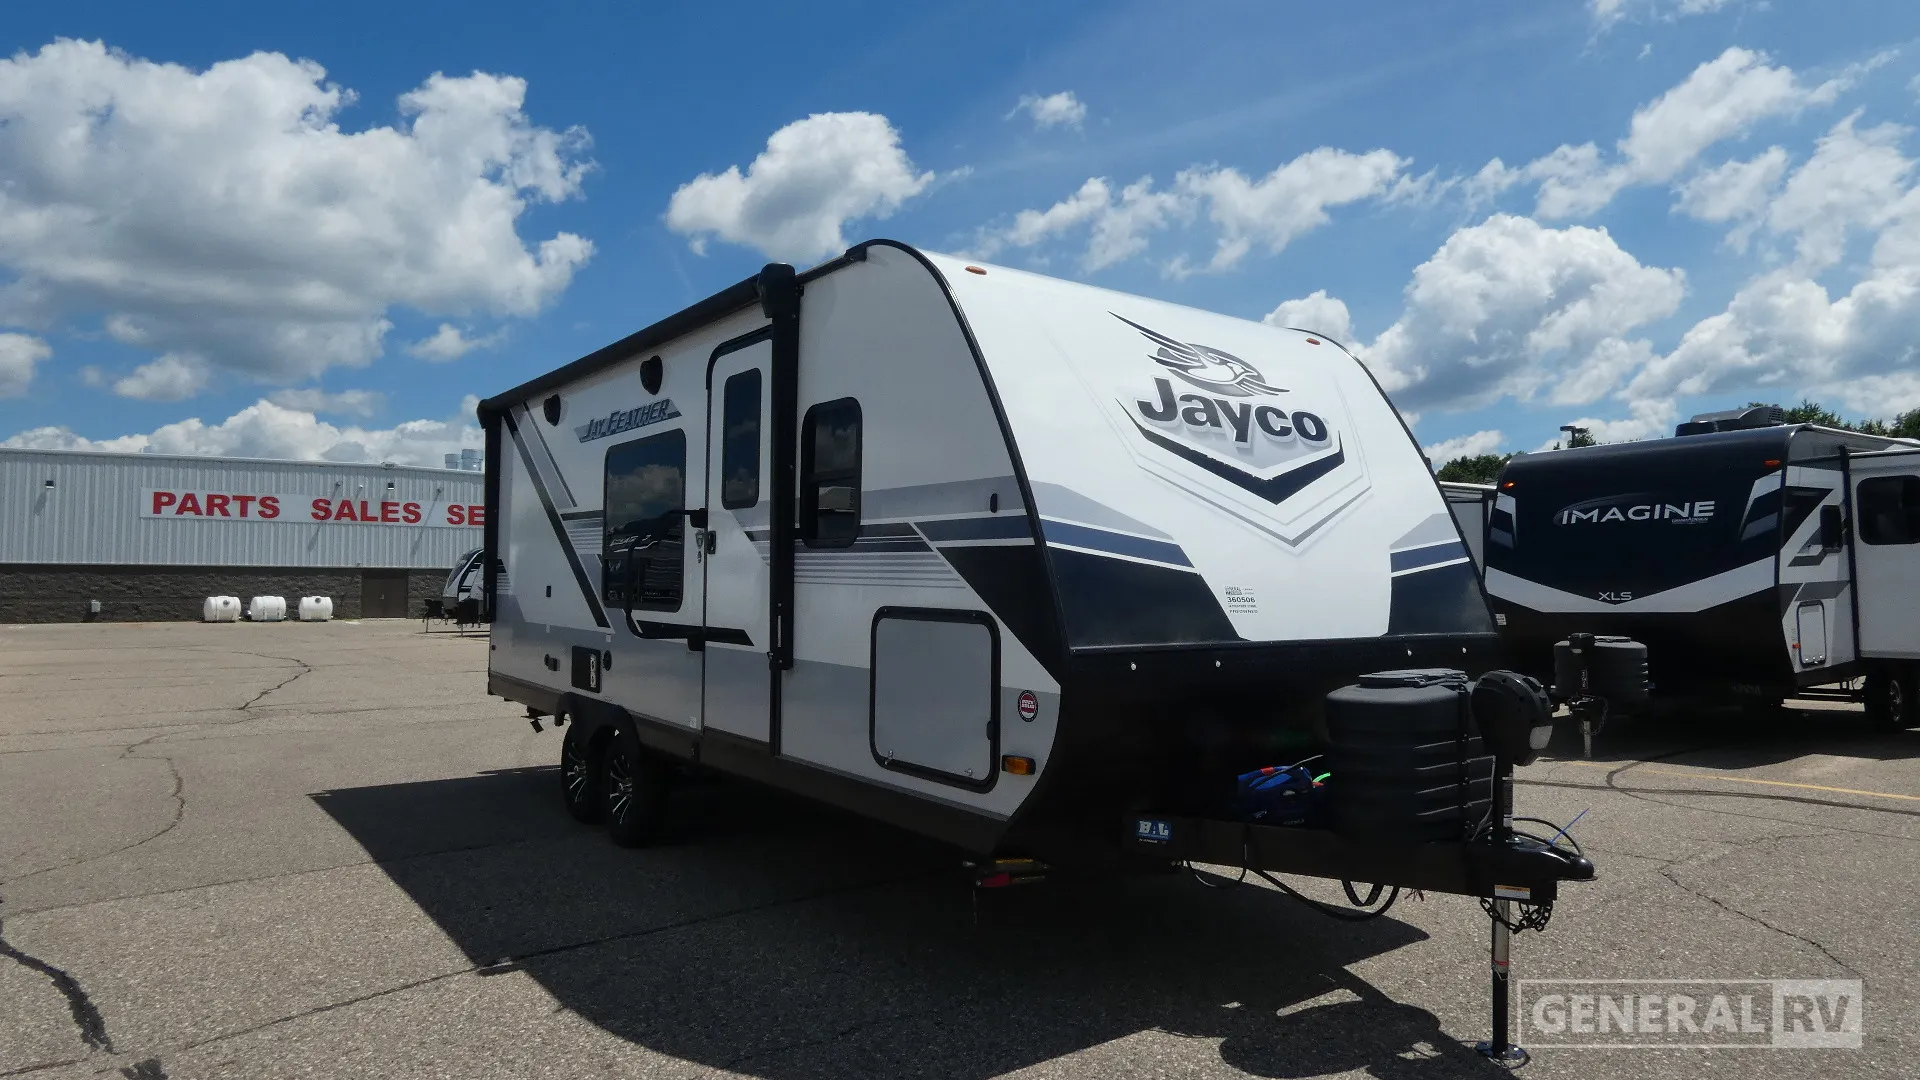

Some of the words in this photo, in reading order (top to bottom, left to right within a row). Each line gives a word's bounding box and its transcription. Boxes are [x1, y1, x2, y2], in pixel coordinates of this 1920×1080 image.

[583, 418, 607, 440] JAY
[607, 398, 670, 434] FEATHER
[1136, 377, 1329, 445] Jayco
[153, 491, 280, 519] PARTS
[311, 499, 422, 524] SALES
[1561, 501, 1715, 525] IMAGINE
[1598, 591, 1632, 601] XLS
